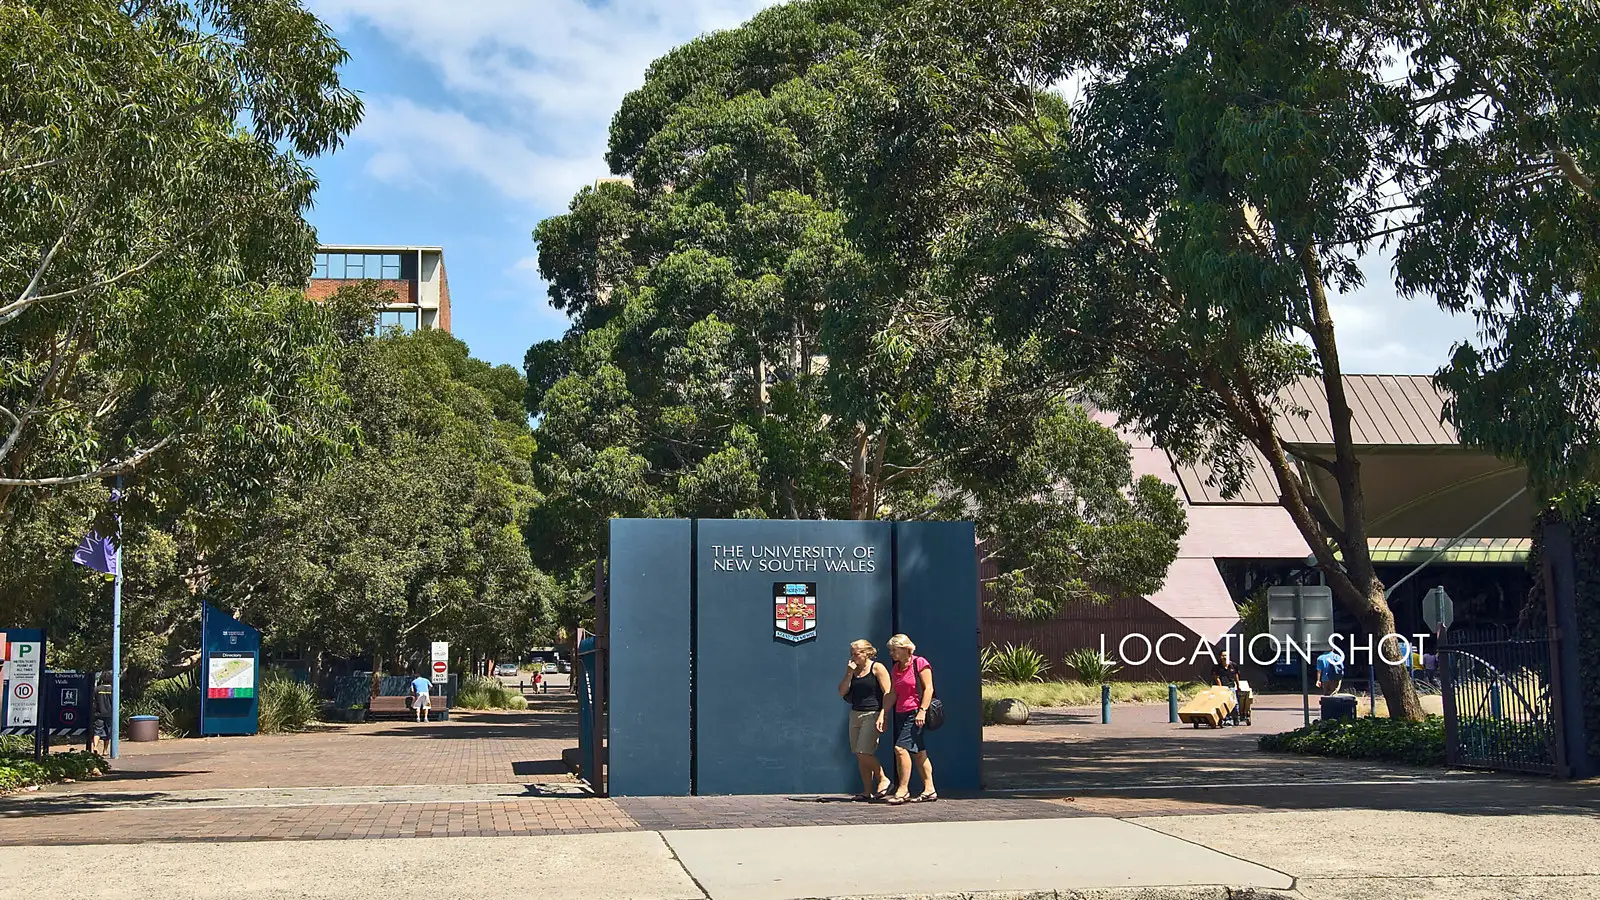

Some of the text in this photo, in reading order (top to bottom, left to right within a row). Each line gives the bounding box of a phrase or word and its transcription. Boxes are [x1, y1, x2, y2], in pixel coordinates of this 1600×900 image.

[711, 545, 875, 559] THE UNIVERSITY OF
[713, 559, 875, 573] NEW SOUTH WALES
[19, 644, 32, 658] P
[18, 686, 30, 696] 10
[63, 712, 74, 720] 10
